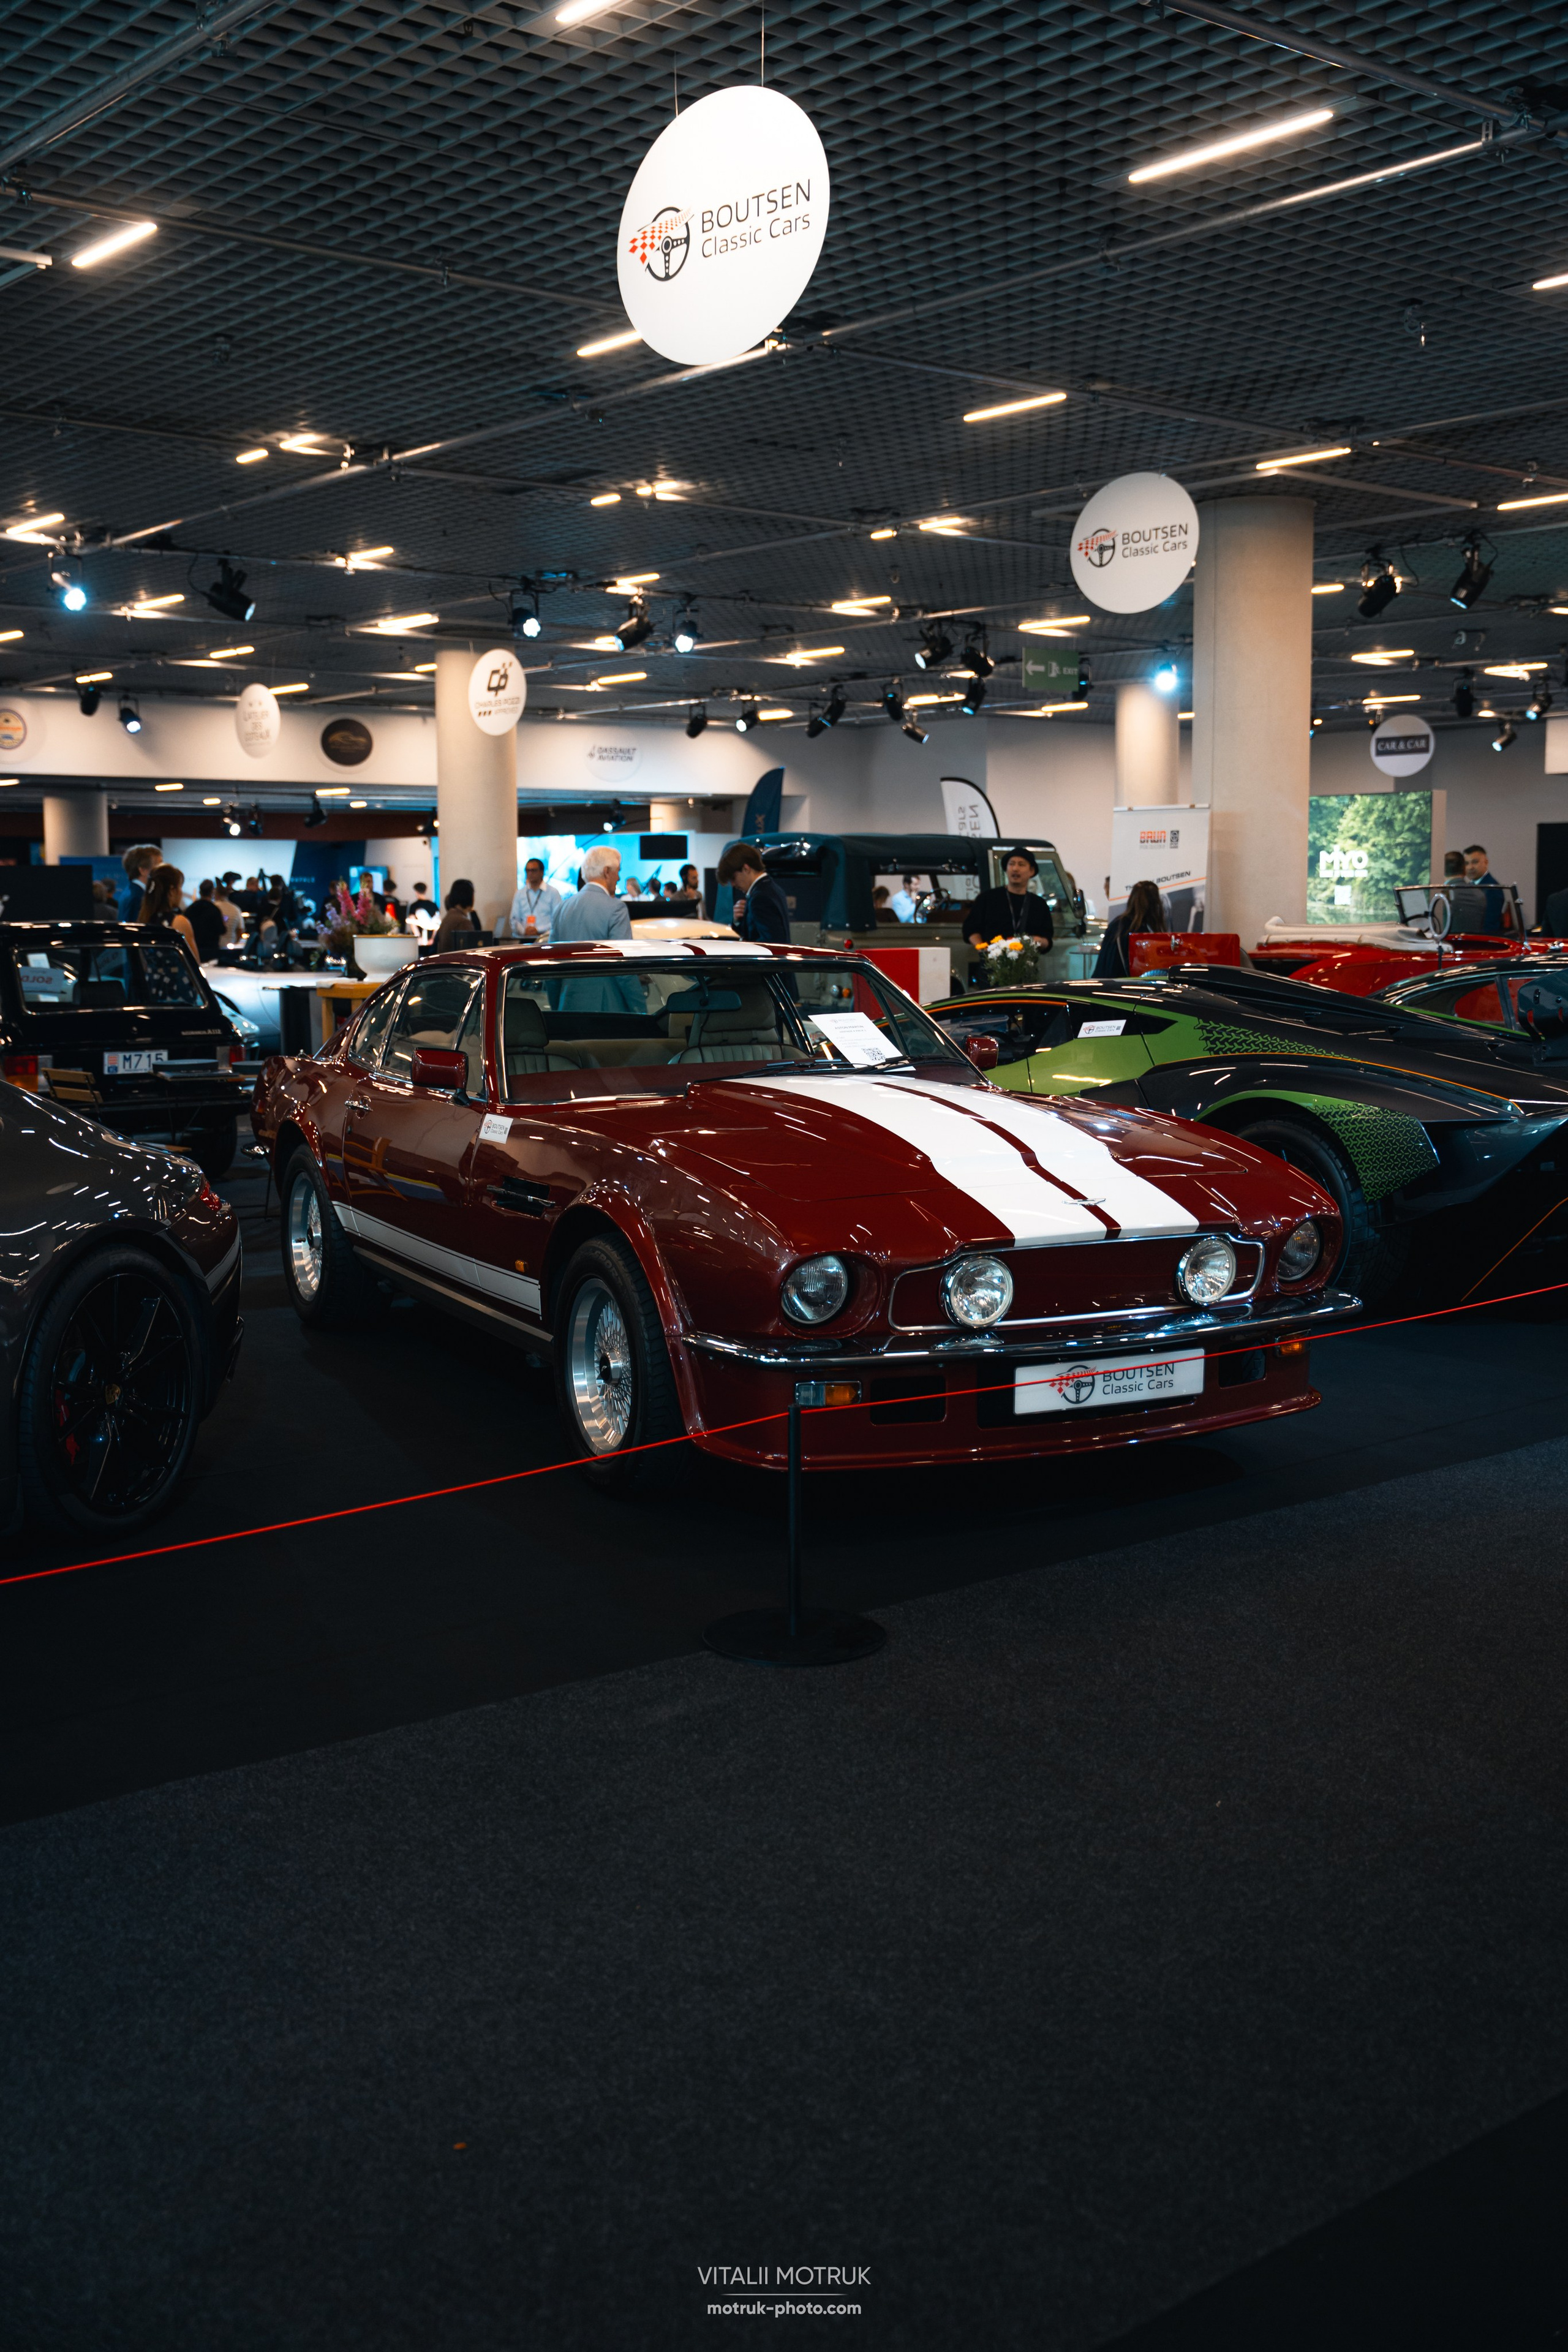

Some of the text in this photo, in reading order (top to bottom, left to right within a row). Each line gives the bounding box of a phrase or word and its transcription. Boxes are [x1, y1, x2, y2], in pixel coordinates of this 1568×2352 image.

[702, 178, 810, 234] BOUTSEN
[702, 214, 810, 258] Classic Cars
[1121, 522, 1188, 545] BOUTSEN
[1121, 540, 1188, 559] Classic Cars
[1378, 739, 1425, 751] CAR & CAR
[1156, 870, 1191, 884] BOUTSEN
[1102, 1362, 1175, 1382] BOUTSEN
[1102, 1379, 1174, 1395] Classic Cars
